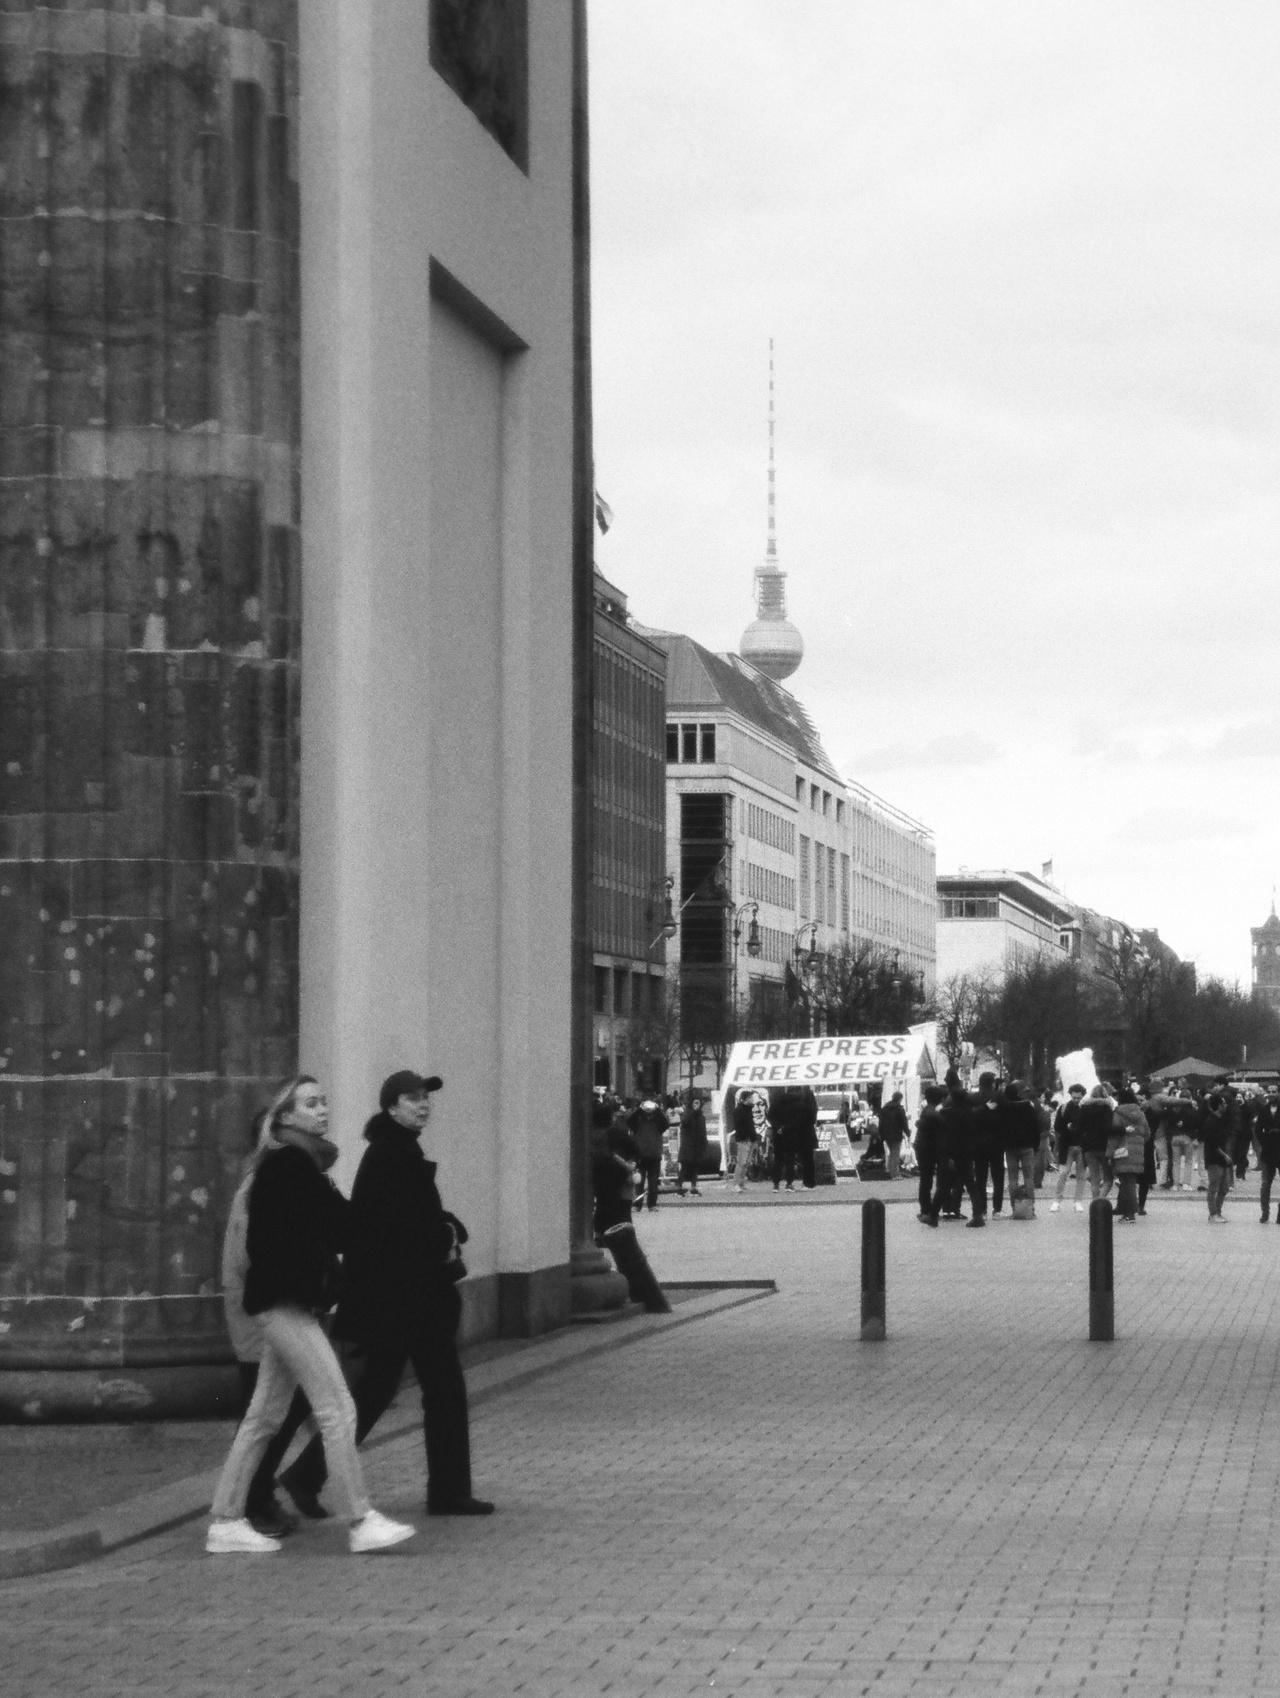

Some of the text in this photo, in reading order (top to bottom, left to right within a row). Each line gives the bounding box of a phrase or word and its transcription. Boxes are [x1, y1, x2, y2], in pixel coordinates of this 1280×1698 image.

[748, 1037, 906, 1060] FREE PRESS
[733, 1060, 909, 1082] FREE SPEECH
